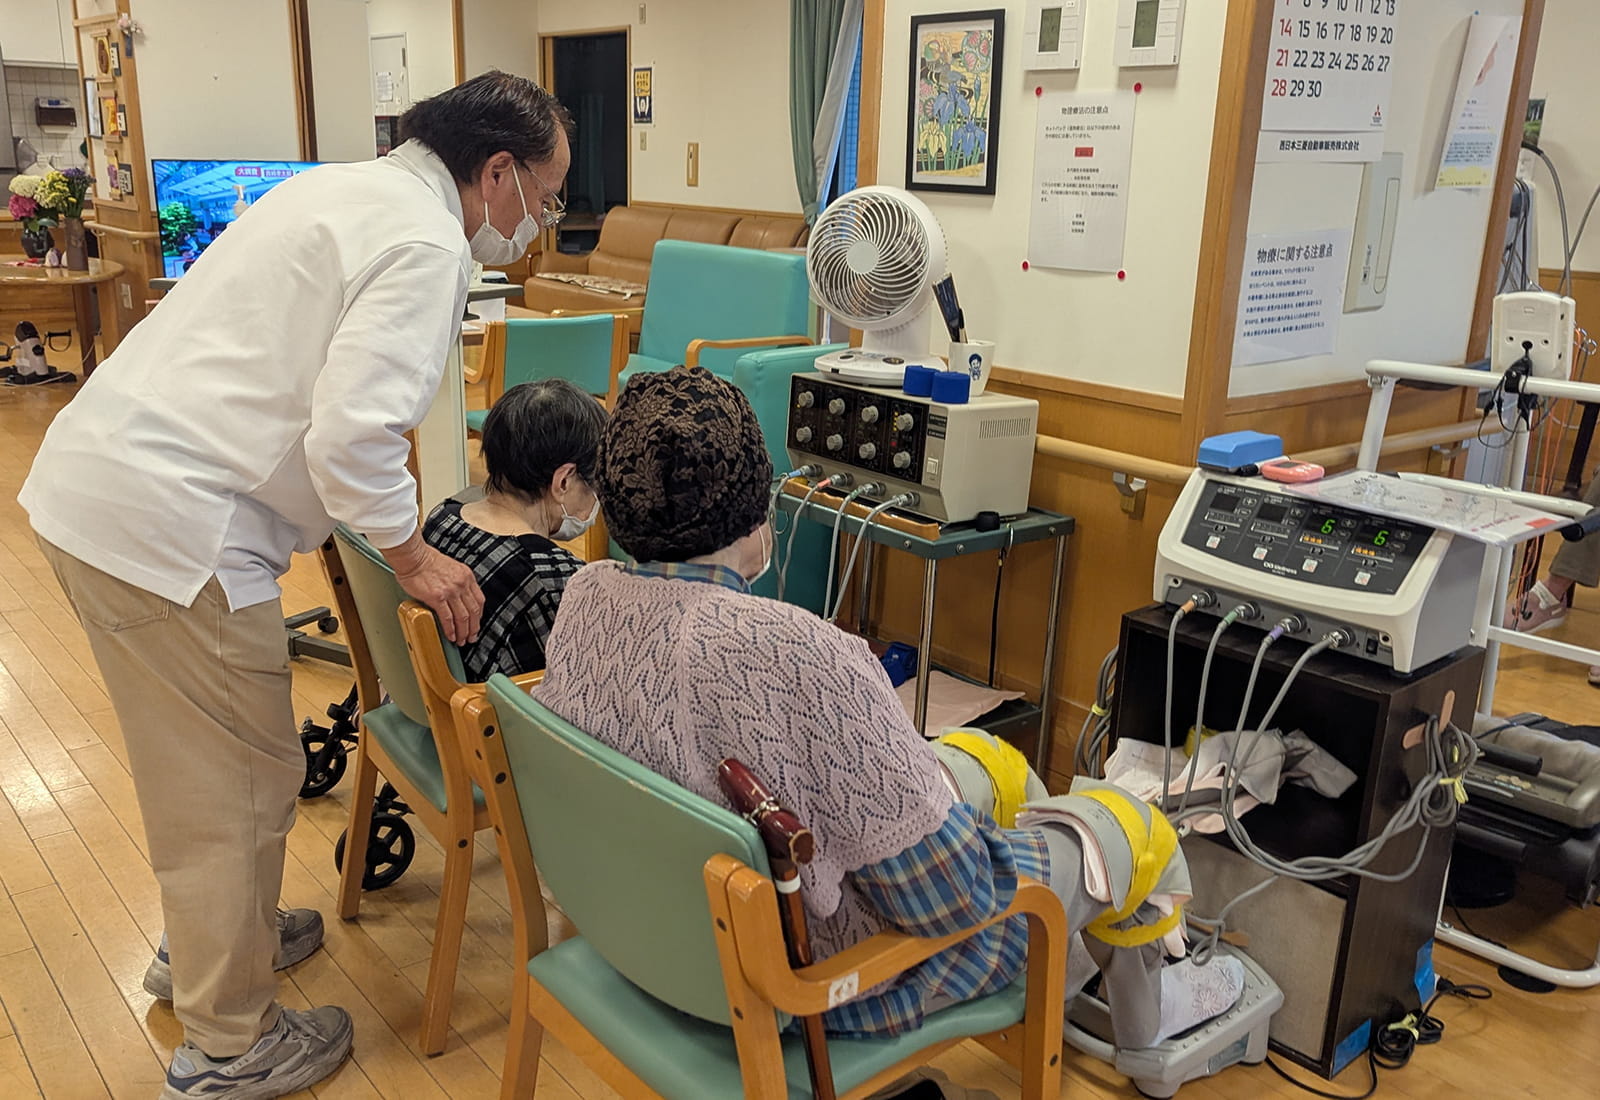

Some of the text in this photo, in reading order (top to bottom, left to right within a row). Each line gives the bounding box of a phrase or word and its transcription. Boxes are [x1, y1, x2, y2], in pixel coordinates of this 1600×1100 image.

[1337, 0, 1348, 11] 10
[1355, 0, 1363, 13] 11
[1370, 0, 1380, 14] 12
[1385, 0, 1396, 16] 13
[1280, 18, 1393, 44] 14 15 16 17 18 19 20
[1275, 49, 1390, 72] 21 22 23 24 25 26 27
[1271, 78, 1322, 98] 28 29 30
[1279, 139, 1360, 151] 西日本三菱自動車販売株式会社
[1257, 244, 1333, 263] 物療に関する注意点
[1320, 519, 1336, 534] 6
[1373, 530, 1390, 546] 6
